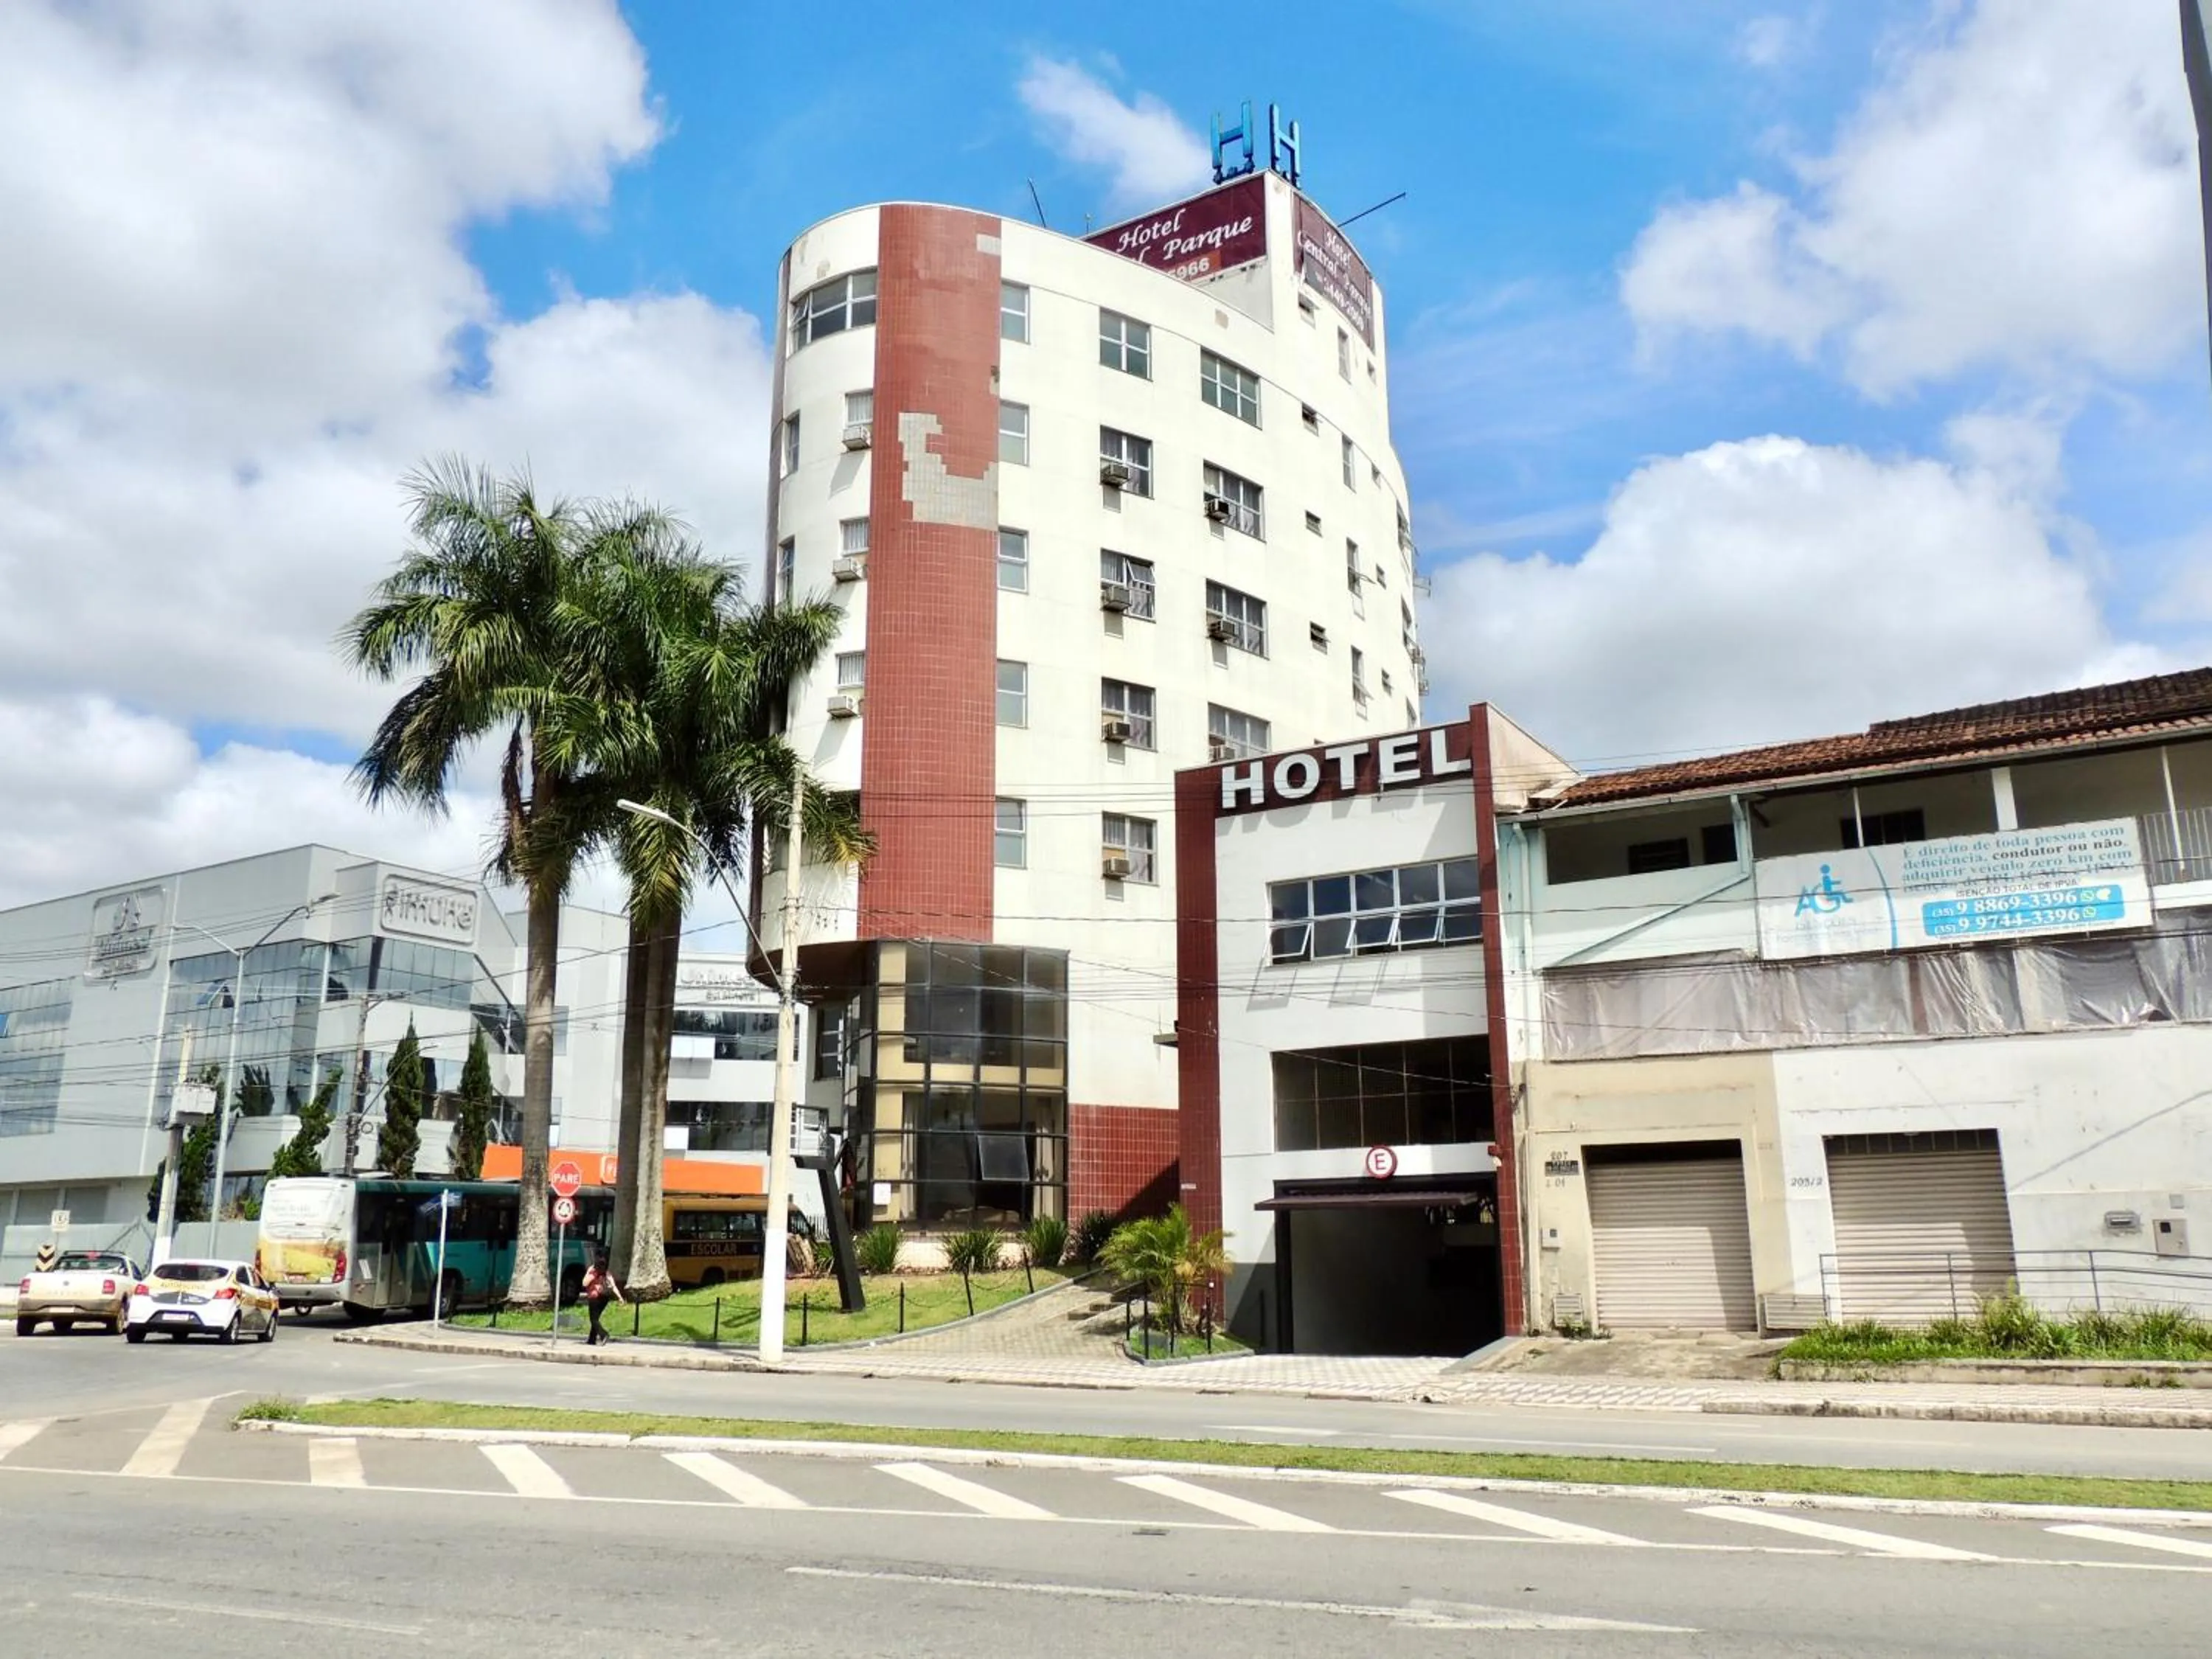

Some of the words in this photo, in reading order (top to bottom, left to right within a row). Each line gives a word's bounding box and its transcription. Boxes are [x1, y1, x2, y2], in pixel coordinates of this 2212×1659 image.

[1116, 209, 1186, 252] Hotel
[1164, 216, 1253, 260] Parque
[1297, 230, 1338, 279] Central
[1326, 231, 1351, 271] Hotel
[1222, 728, 1471, 809] HOTEL
[1919, 841, 1968, 857] direito
[1972, 841, 1990, 851] de
[1996, 837, 2029, 847] toda
[2035, 830, 2086, 846] pessoa
[2091, 827, 2124, 838] com
[1993, 846, 2063, 860] condutor
[2068, 842, 2087, 852] ou
[1903, 866, 1966, 882] adquirir
[2030, 858, 2062, 868] zero
[2067, 853, 2093, 863] km
[2098, 849, 2132, 860] com
[1956, 885, 2001, 897] ISENÇÃO
[2004, 883, 2034, 894] TOTAL
[2038, 881, 2053, 889] DE
[1933, 908, 1954, 918] (35)
[1956, 901, 1968, 914] 9
[1974, 890, 2077, 913] 8869-3396
[1934, 925, 1956, 934] (35)
[1958, 918, 1969, 931] 9
[1975, 908, 2079, 930] 9744-3396
[1374, 1152, 1386, 1170] E
[554, 1173, 580, 1185] PARE
[691, 1242, 737, 1255] ESCOLAR
